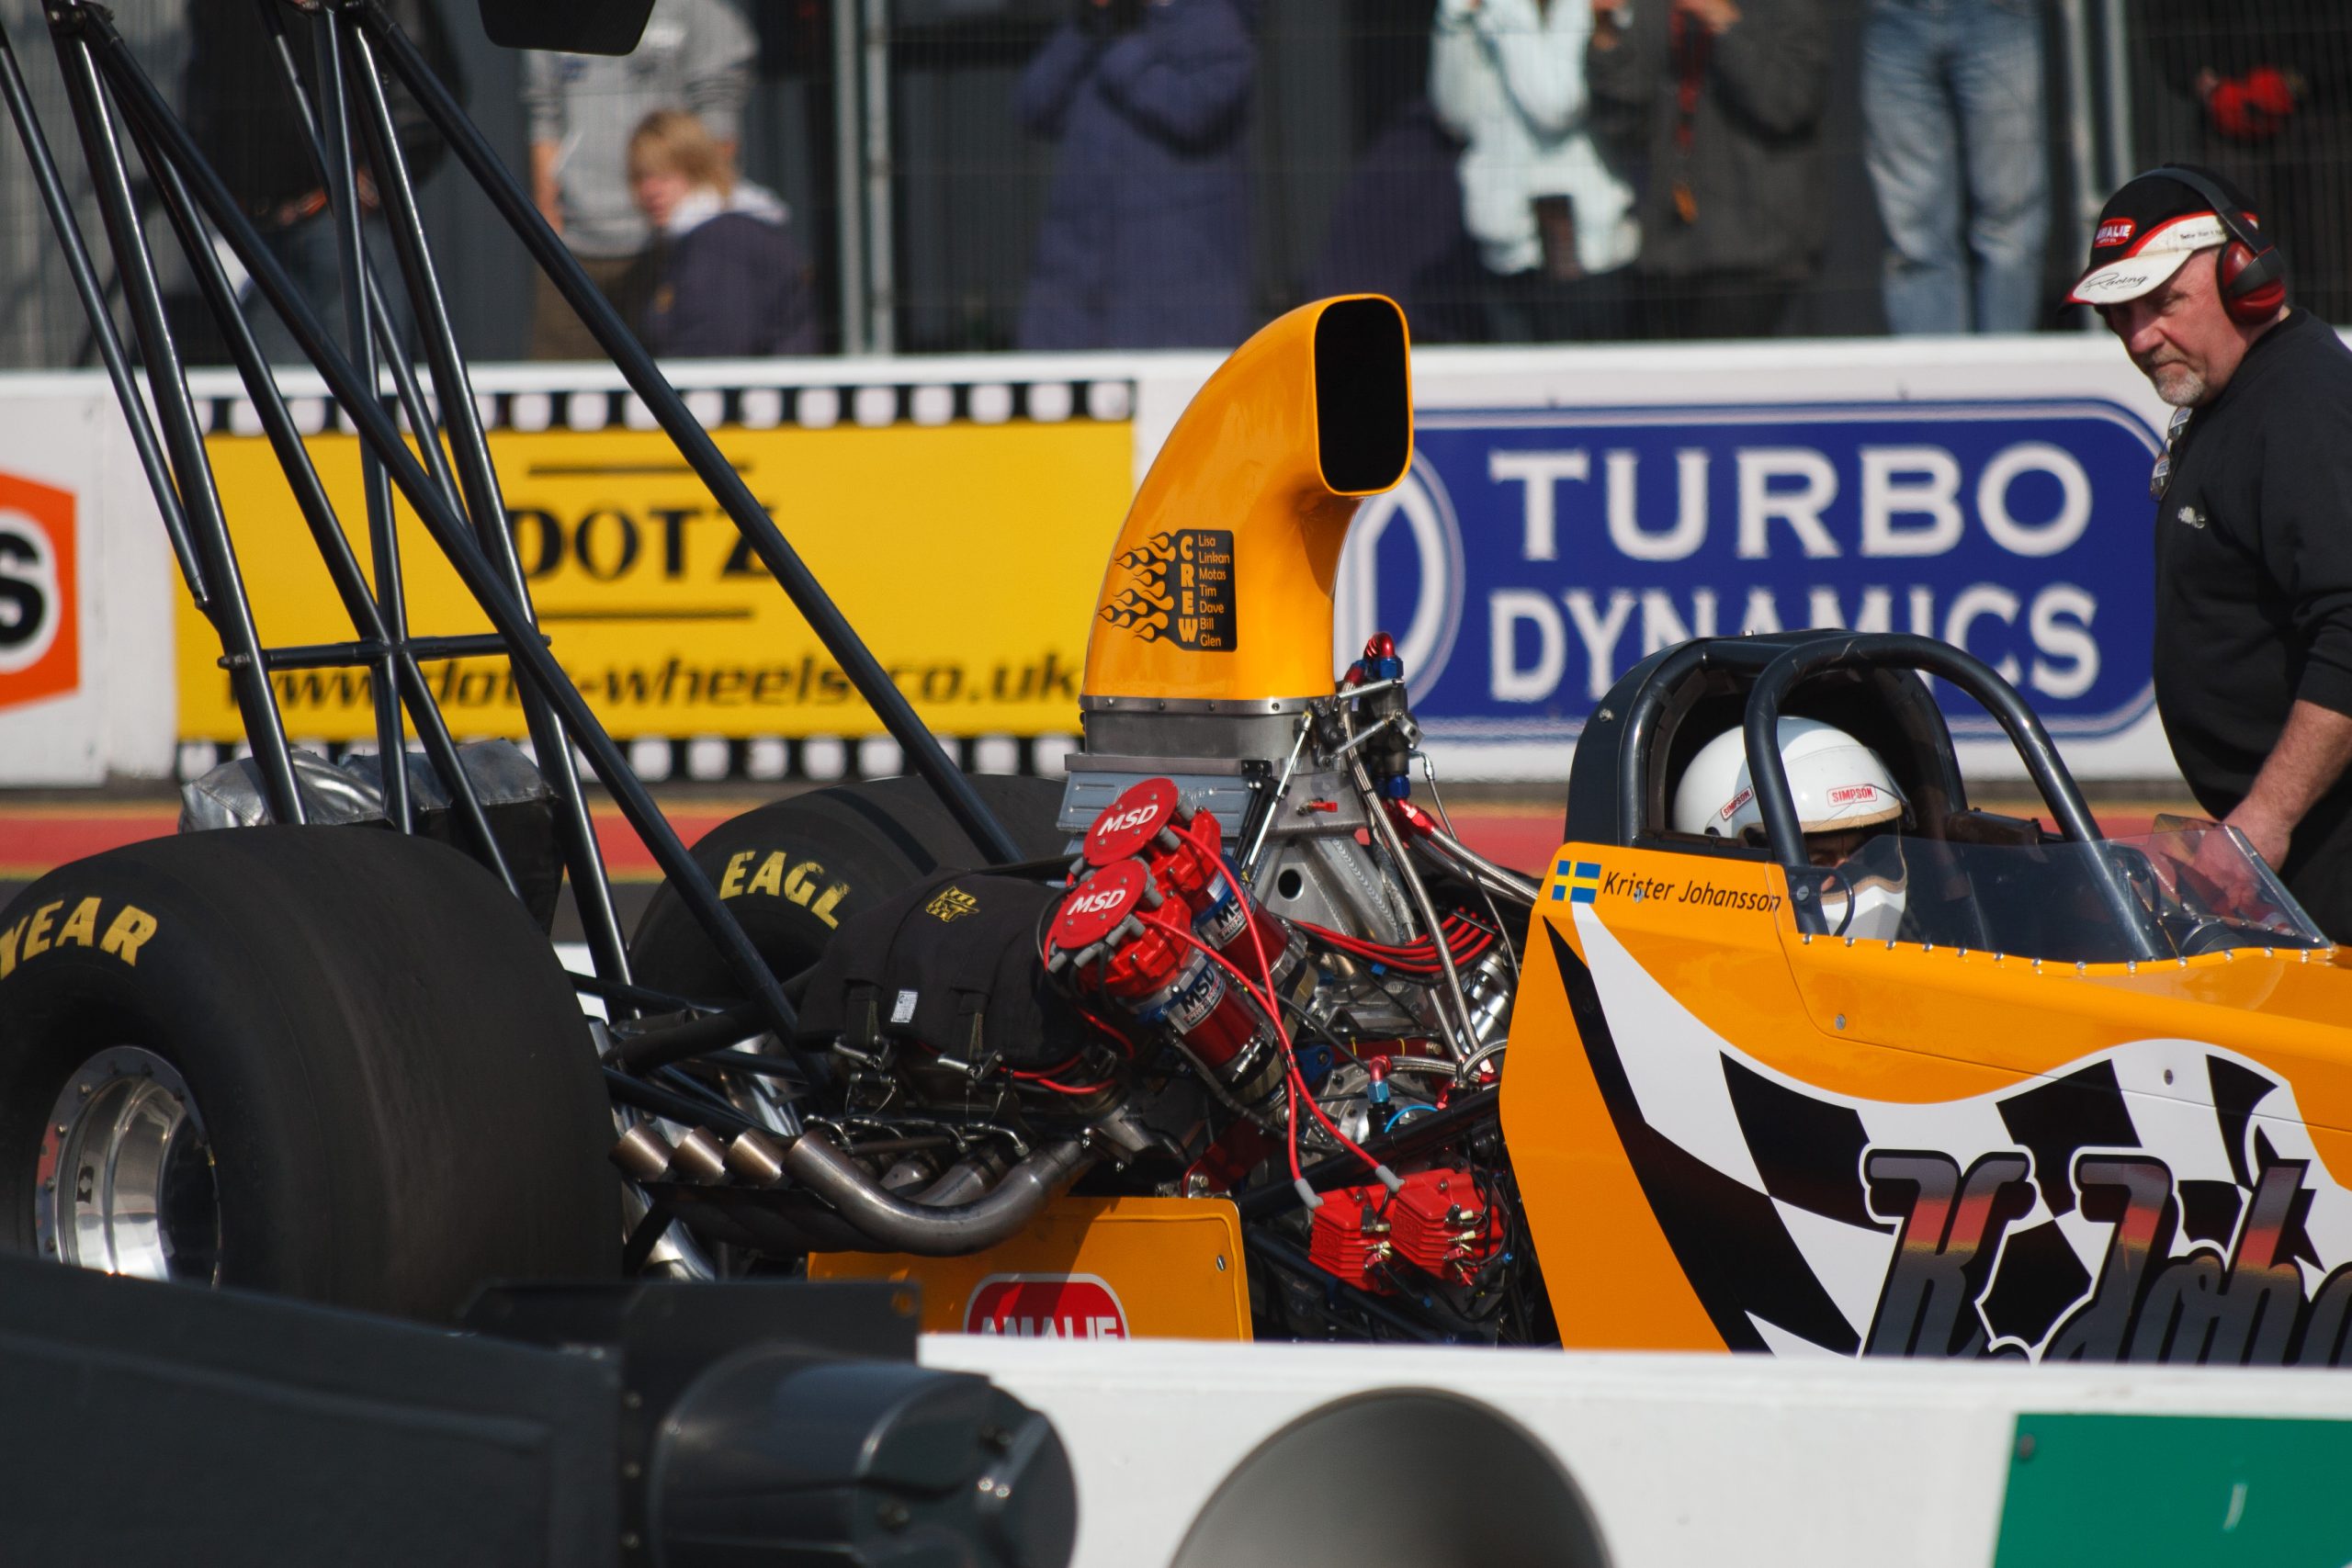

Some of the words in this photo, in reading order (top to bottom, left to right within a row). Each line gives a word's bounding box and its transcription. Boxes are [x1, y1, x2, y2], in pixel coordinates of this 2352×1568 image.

[2084, 272, 2148, 292] Racing
[1488, 443, 2092, 560] TURBO
[1198, 535, 1216, 547] Lisa
[1198, 551, 1230, 565] Linkan
[1199, 584, 1217, 597] Tim
[1200, 601, 1225, 615] Dave
[1200, 618, 1215, 630] Bill
[1200, 635, 1222, 648] Glen
[1723, 789, 1751, 817] SIMPSON
[1831, 787, 1874, 803] SIMPSON
[1096, 804, 1159, 837] MSD
[1602, 871, 1675, 901] Krister
[1678, 880, 1782, 913] Johansson
[1067, 889, 1126, 917] MSD
[0, 896, 158, 980] YEAR
[1181, 965, 1216, 1014] MSD
